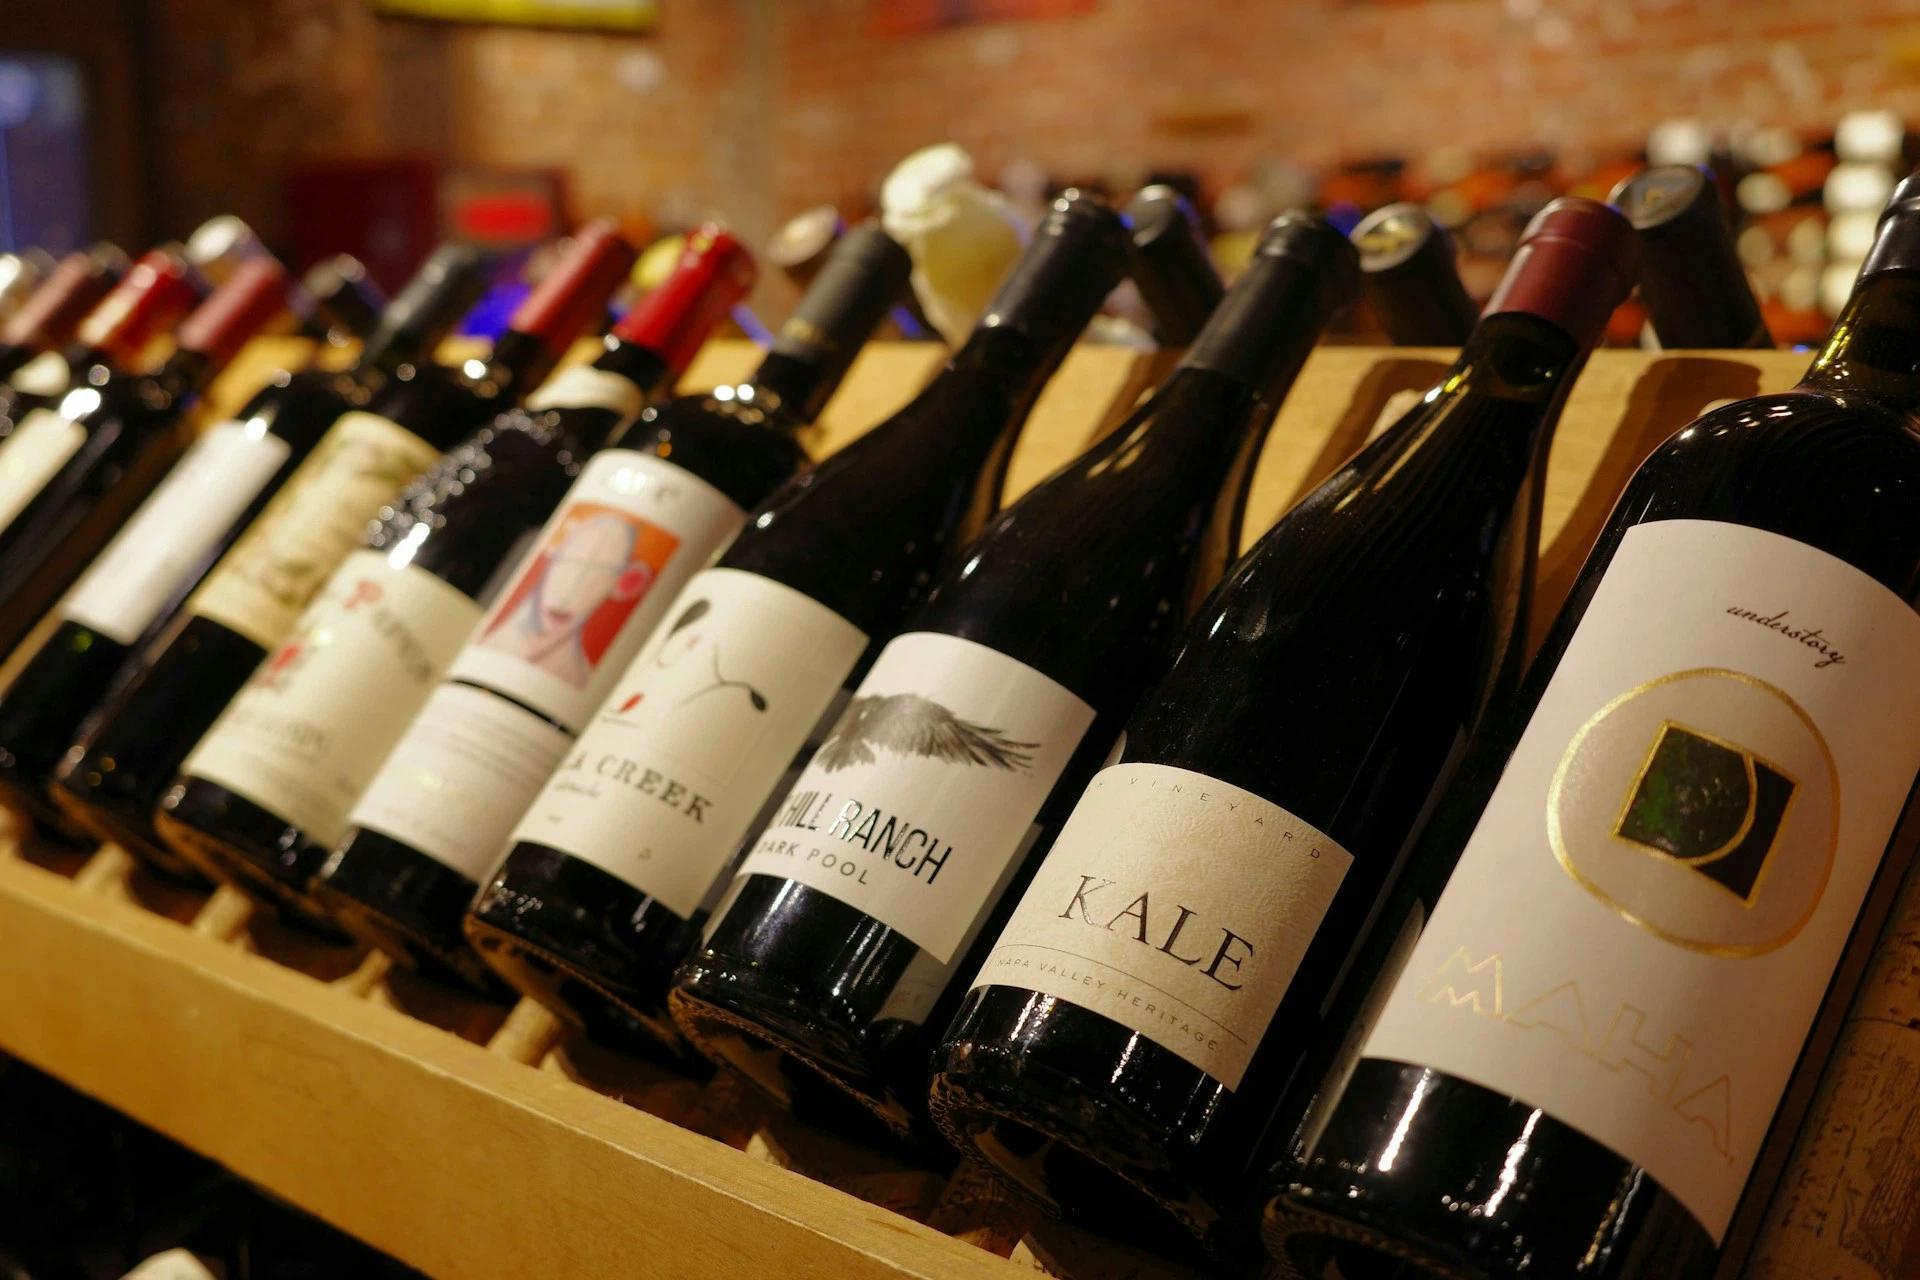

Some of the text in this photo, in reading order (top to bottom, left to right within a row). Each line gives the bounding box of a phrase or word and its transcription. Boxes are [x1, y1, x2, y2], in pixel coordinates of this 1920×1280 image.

[1726, 606, 1846, 668] understory
[596, 754, 714, 823] CREEK
[1130, 777, 1321, 859] VINEYARD
[778, 790, 953, 885] HILL RANCH
[806, 848, 868, 885] POOL
[1057, 874, 1254, 991] KALE
[1039, 961, 1105, 987] VALLEY
[1116, 988, 1218, 1051] HERITAGE
[1416, 945, 1735, 1167] MAHA
